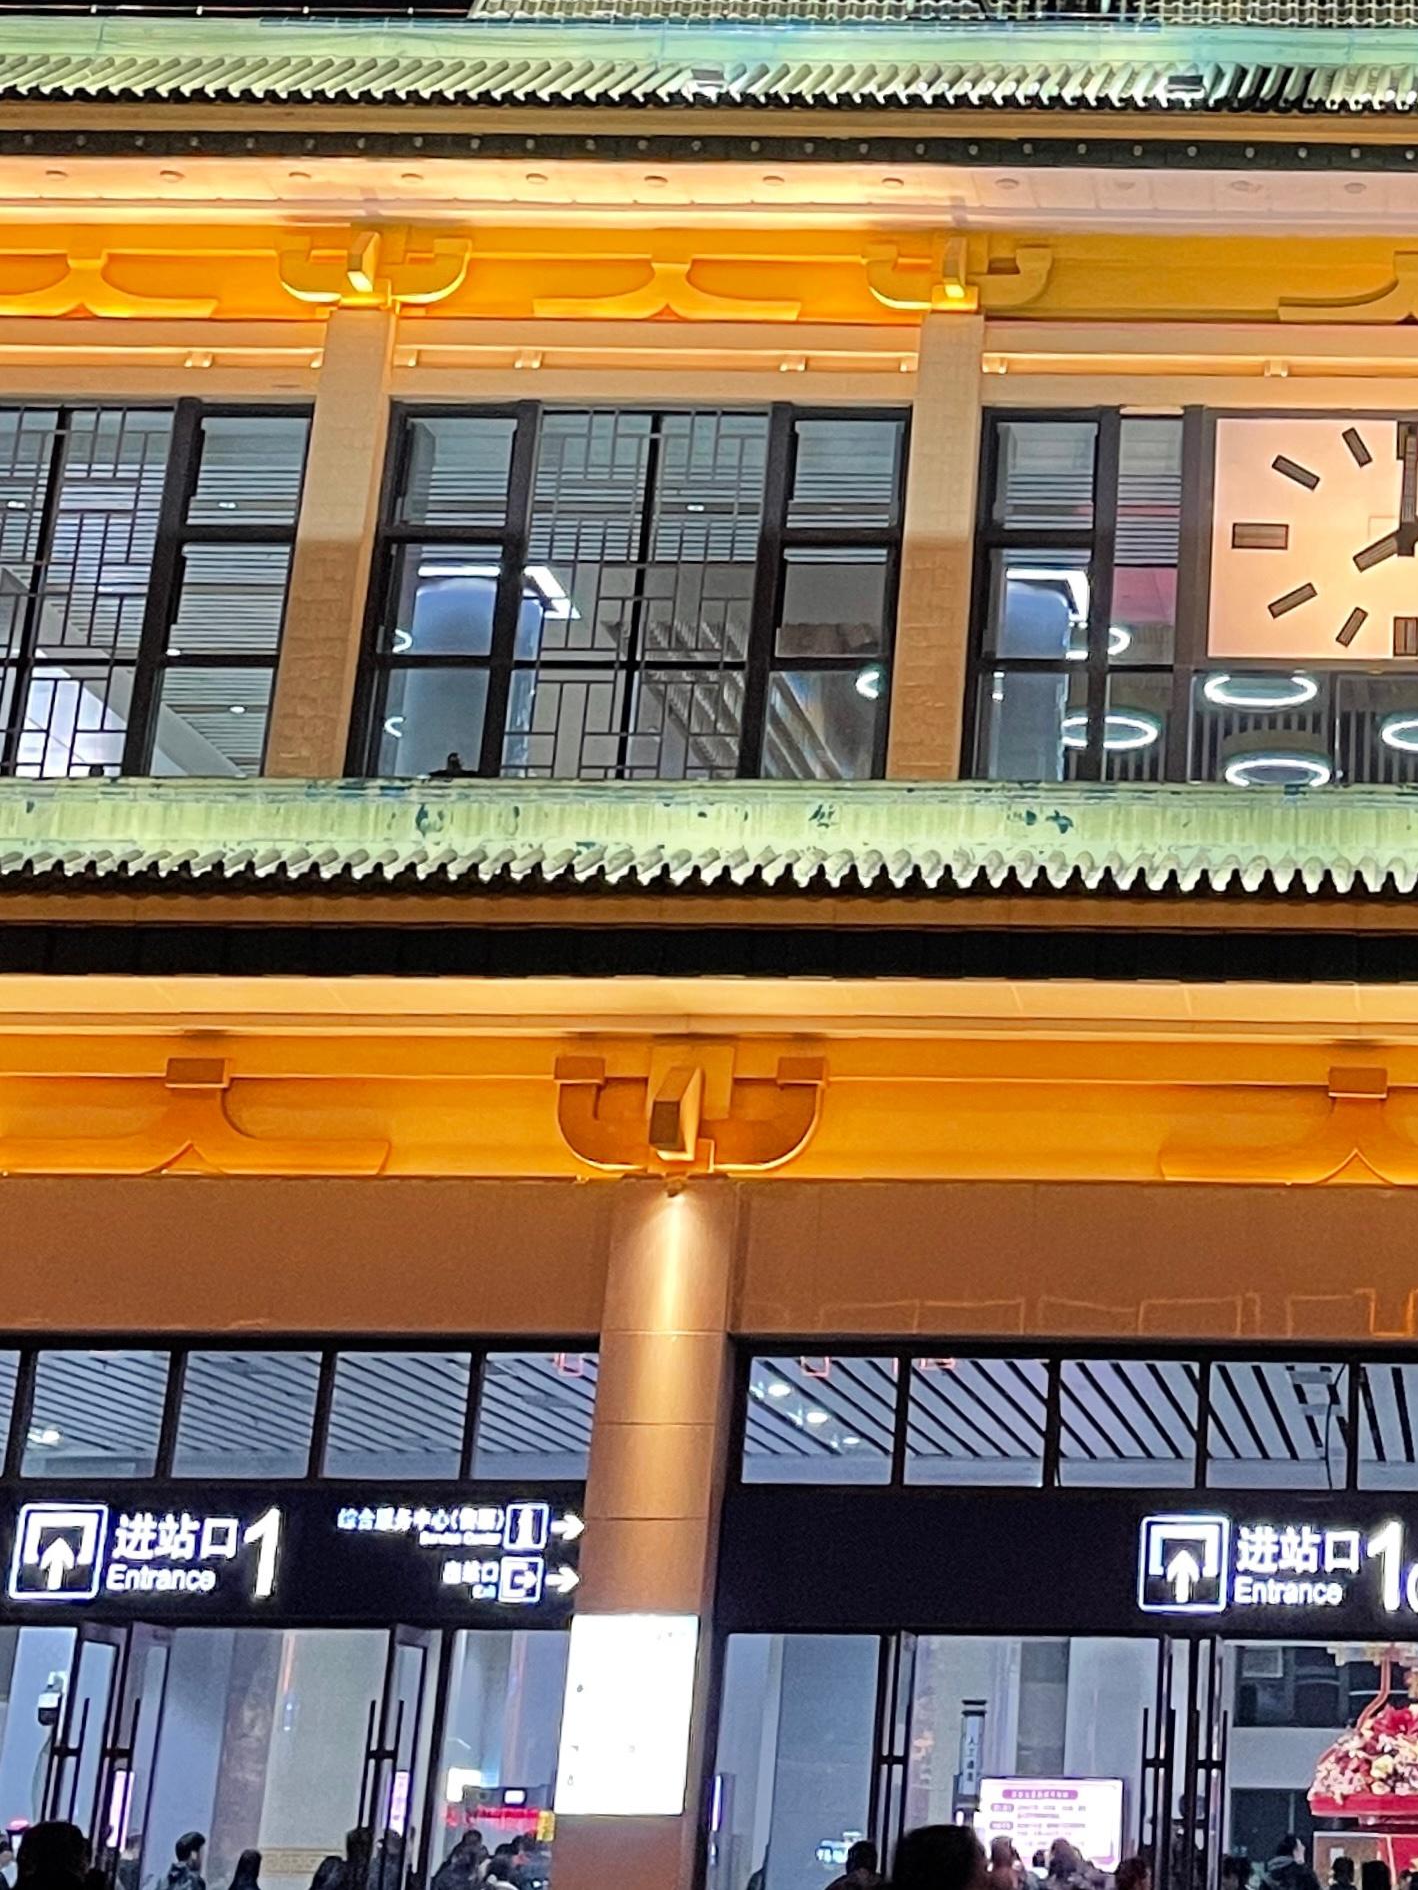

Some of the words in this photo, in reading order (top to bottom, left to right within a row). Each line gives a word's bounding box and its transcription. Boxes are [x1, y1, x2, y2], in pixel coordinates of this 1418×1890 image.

[105, 1563, 216, 1592] Entrance
[112, 1512, 239, 1560] 进站口
[243, 1507, 281, 1599] 1
[1236, 1524, 1360, 1574] 进站口
[1366, 1520, 1403, 1613] 1
[1233, 1575, 1344, 1606] Entrance
